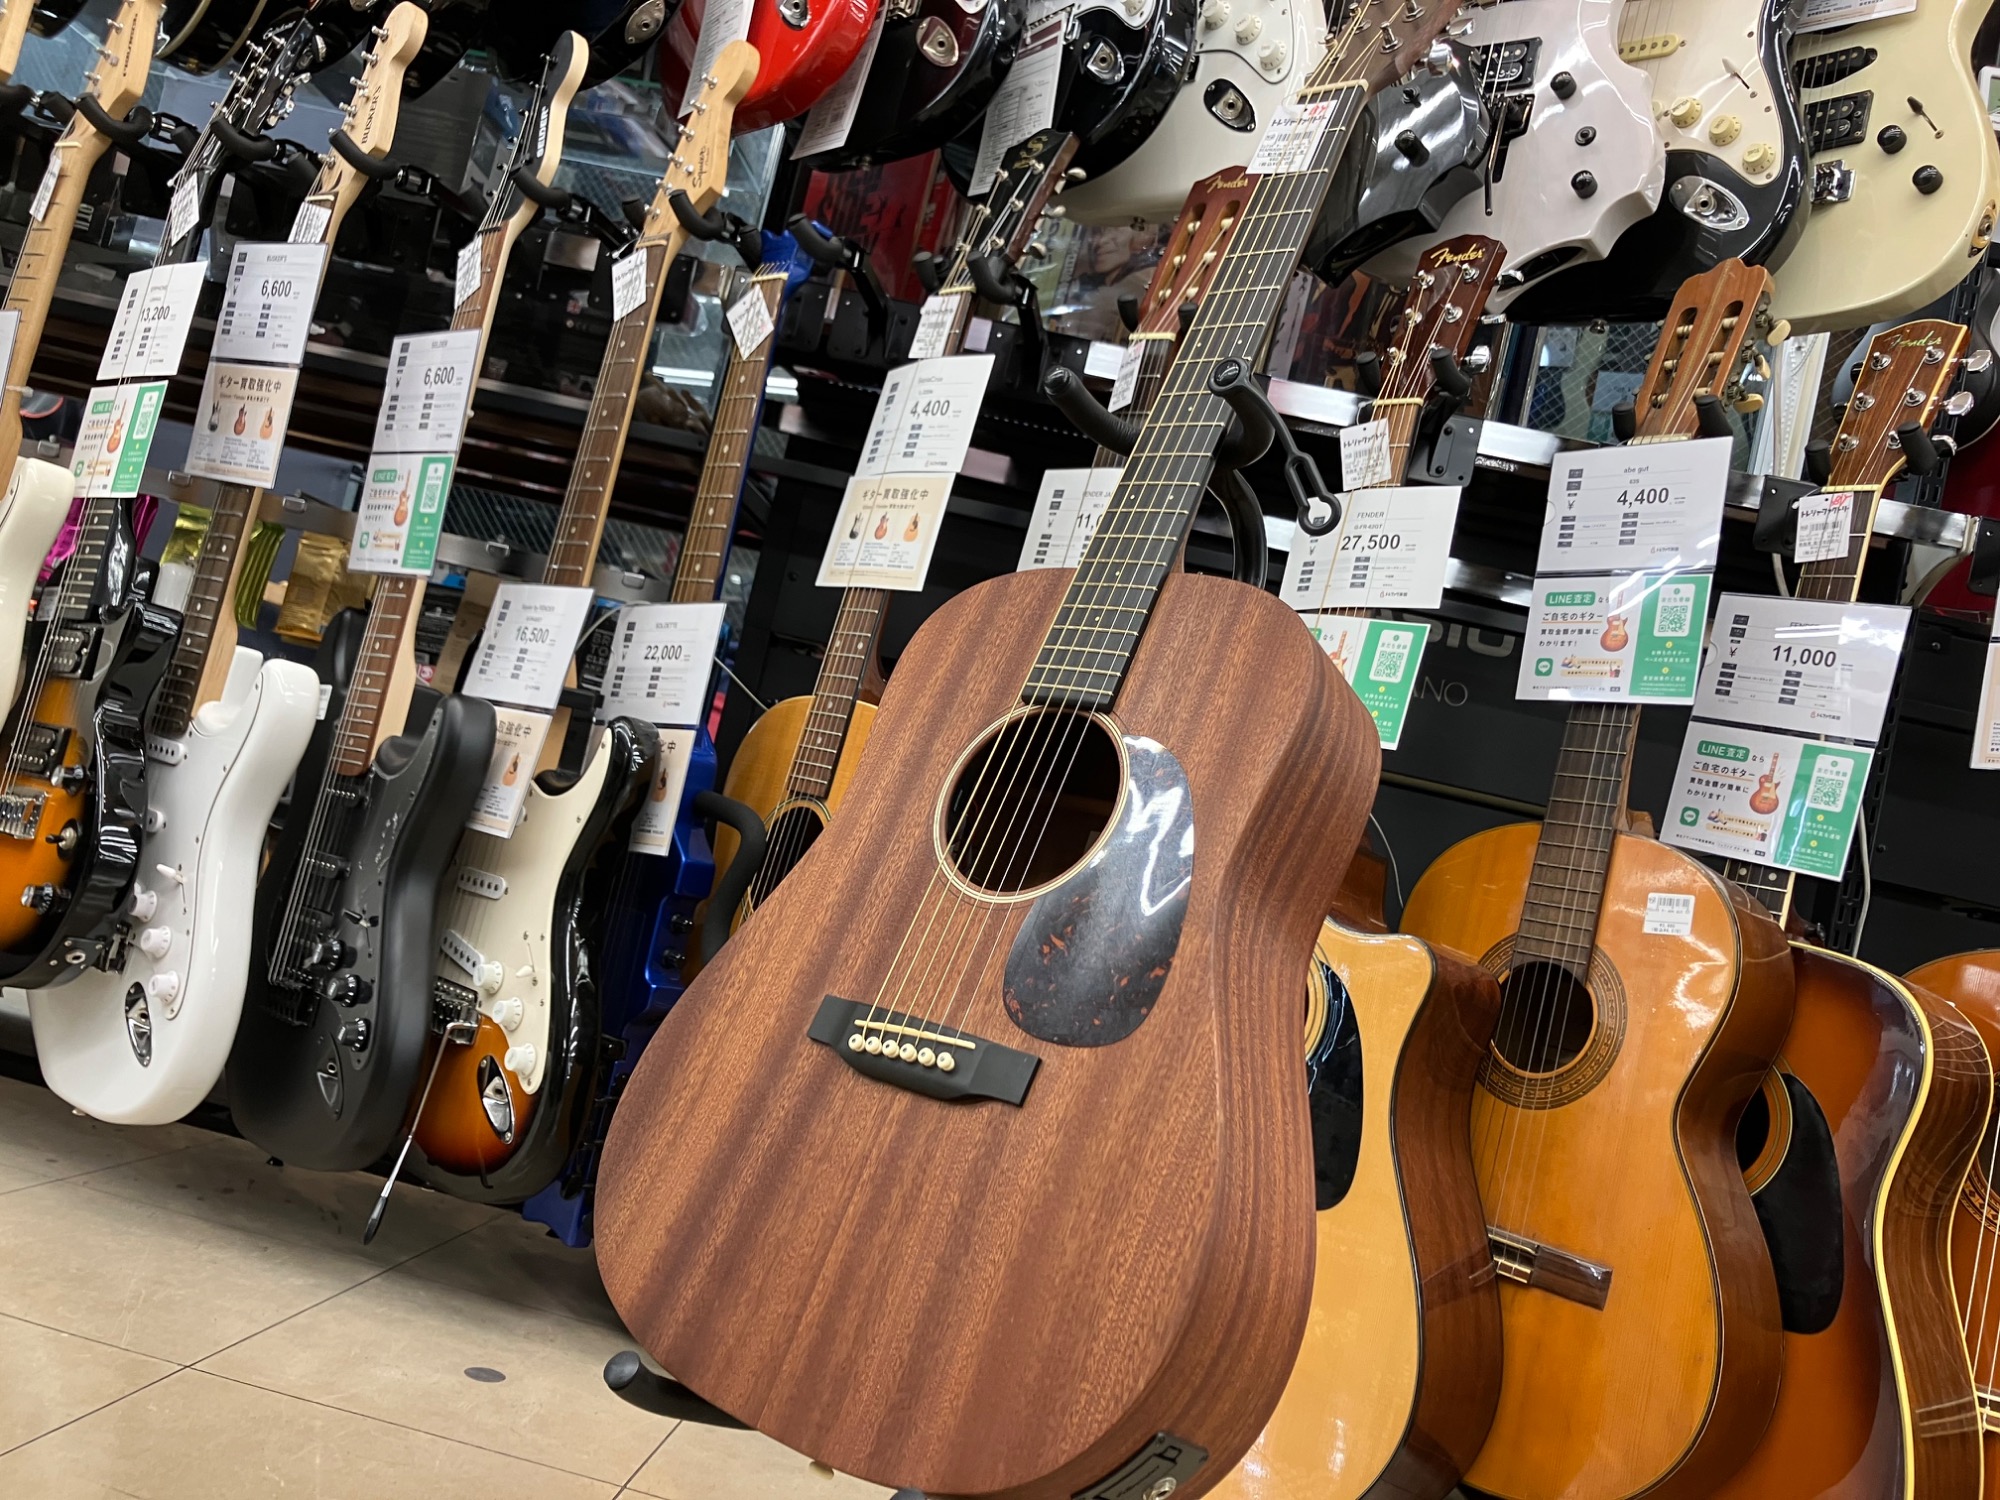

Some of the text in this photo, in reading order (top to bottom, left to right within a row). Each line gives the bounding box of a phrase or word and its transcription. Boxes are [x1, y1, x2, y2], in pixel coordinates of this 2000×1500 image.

[1205, 172, 1249, 194] Fender
[1430, 243, 1484, 268] Fender
[261, 279, 292, 300] 6,600
[140, 305, 171, 323] 13,200
[1884, 330, 1943, 350] Fender
[218, 374, 282, 394] ギター買取強化中
[424, 366, 455, 389] 6,600
[910, 399, 951, 421] 4,400
[1624, 466, 1636, 474] abe
[862, 488, 929, 501] ギター買取強化中
[1616, 487, 1670, 509] 4,400
[1356, 511, 1385, 519] FENDER
[1340, 534, 1401, 553] 27,500
[1549, 592, 1593, 605] LINE査定
[1542, 612, 1604, 622] ご自宅のギター
[515, 626, 550, 644] 16,500
[1540, 628, 1600, 636] 買取金額が簡単に
[643, 644, 683, 663] 22,000
[1728, 644, 1838, 668] ¥ 11,000
[1701, 744, 1765, 763] LINE査定 なら
[1692, 761, 1756, 778] ご自宅のギター
[1689, 776, 1749, 794] 買取金額が簡単に
